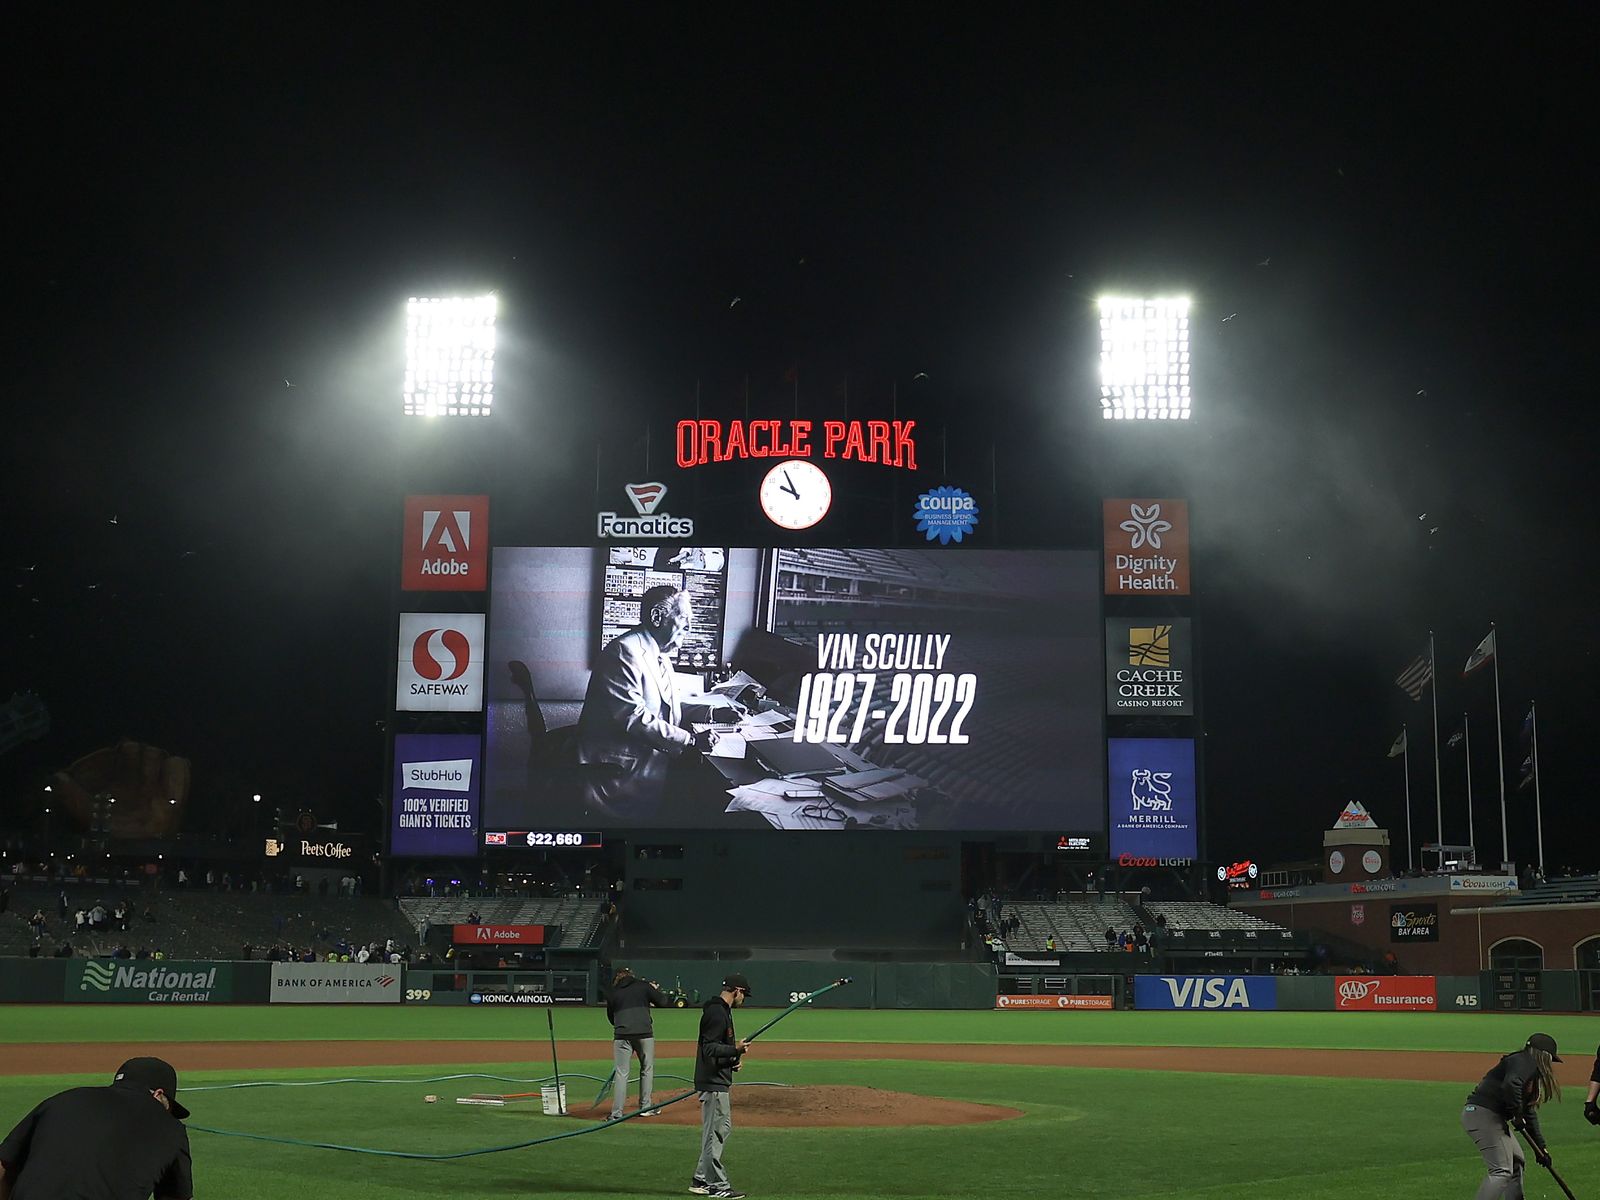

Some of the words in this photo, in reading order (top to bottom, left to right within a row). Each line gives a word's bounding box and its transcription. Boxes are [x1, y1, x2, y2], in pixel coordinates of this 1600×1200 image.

[677, 420, 812, 468] ORACLE
[823, 420, 917, 470] PARK
[920, 496, 974, 514] coupa
[600, 514, 692, 536] Fanatics
[421, 558, 469, 575] Adobe
[1115, 555, 1177, 574] Dignity
[817, 633, 858, 670] VIN
[862, 633, 951, 670] SCULLY
[1116, 670, 1183, 682] CACHE
[410, 683, 468, 695] SAFEWAY
[1118, 684, 1181, 697] CREEK
[793, 672, 977, 745] 1927-2022
[411, 769, 462, 781] StubHub
[403, 798, 427, 812] 100%
[429, 798, 468, 812] VERIFIED
[399, 814, 431, 828] GIANTS
[433, 814, 471, 828] TICKETS
[1129, 815, 1176, 823] MERRILL
[526, 832, 582, 847] $22,660
[300, 840, 324, 857] Peet's
[324, 842, 352, 859] Coffee
[1119, 852, 1157, 867] Coors
[1159, 857, 1192, 867] LIGHT
[1462, 879, 1486, 888] Coors
[1405, 912, 1437, 928] Sports
[493, 930, 520, 939] Adobe
[1398, 928, 1411, 936] BAY
[1411, 927, 1430, 935] AREA
[114, 966, 217, 989] National
[277, 978, 307, 987] BANK
[309, 978, 323, 987] OF
[325, 978, 372, 987] AMERICA
[405, 989, 431, 1000] 399
[1160, 977, 1250, 1008] VISA
[1342, 981, 1365, 996] AAA
[148, 991, 169, 1001] Car
[171, 991, 210, 1001] Rental
[482, 994, 515, 1003] KONICA
[515, 994, 553, 1003] MINOLTA
[1374, 994, 1434, 1004] Insurance
[1455, 994, 1478, 1006] 415
